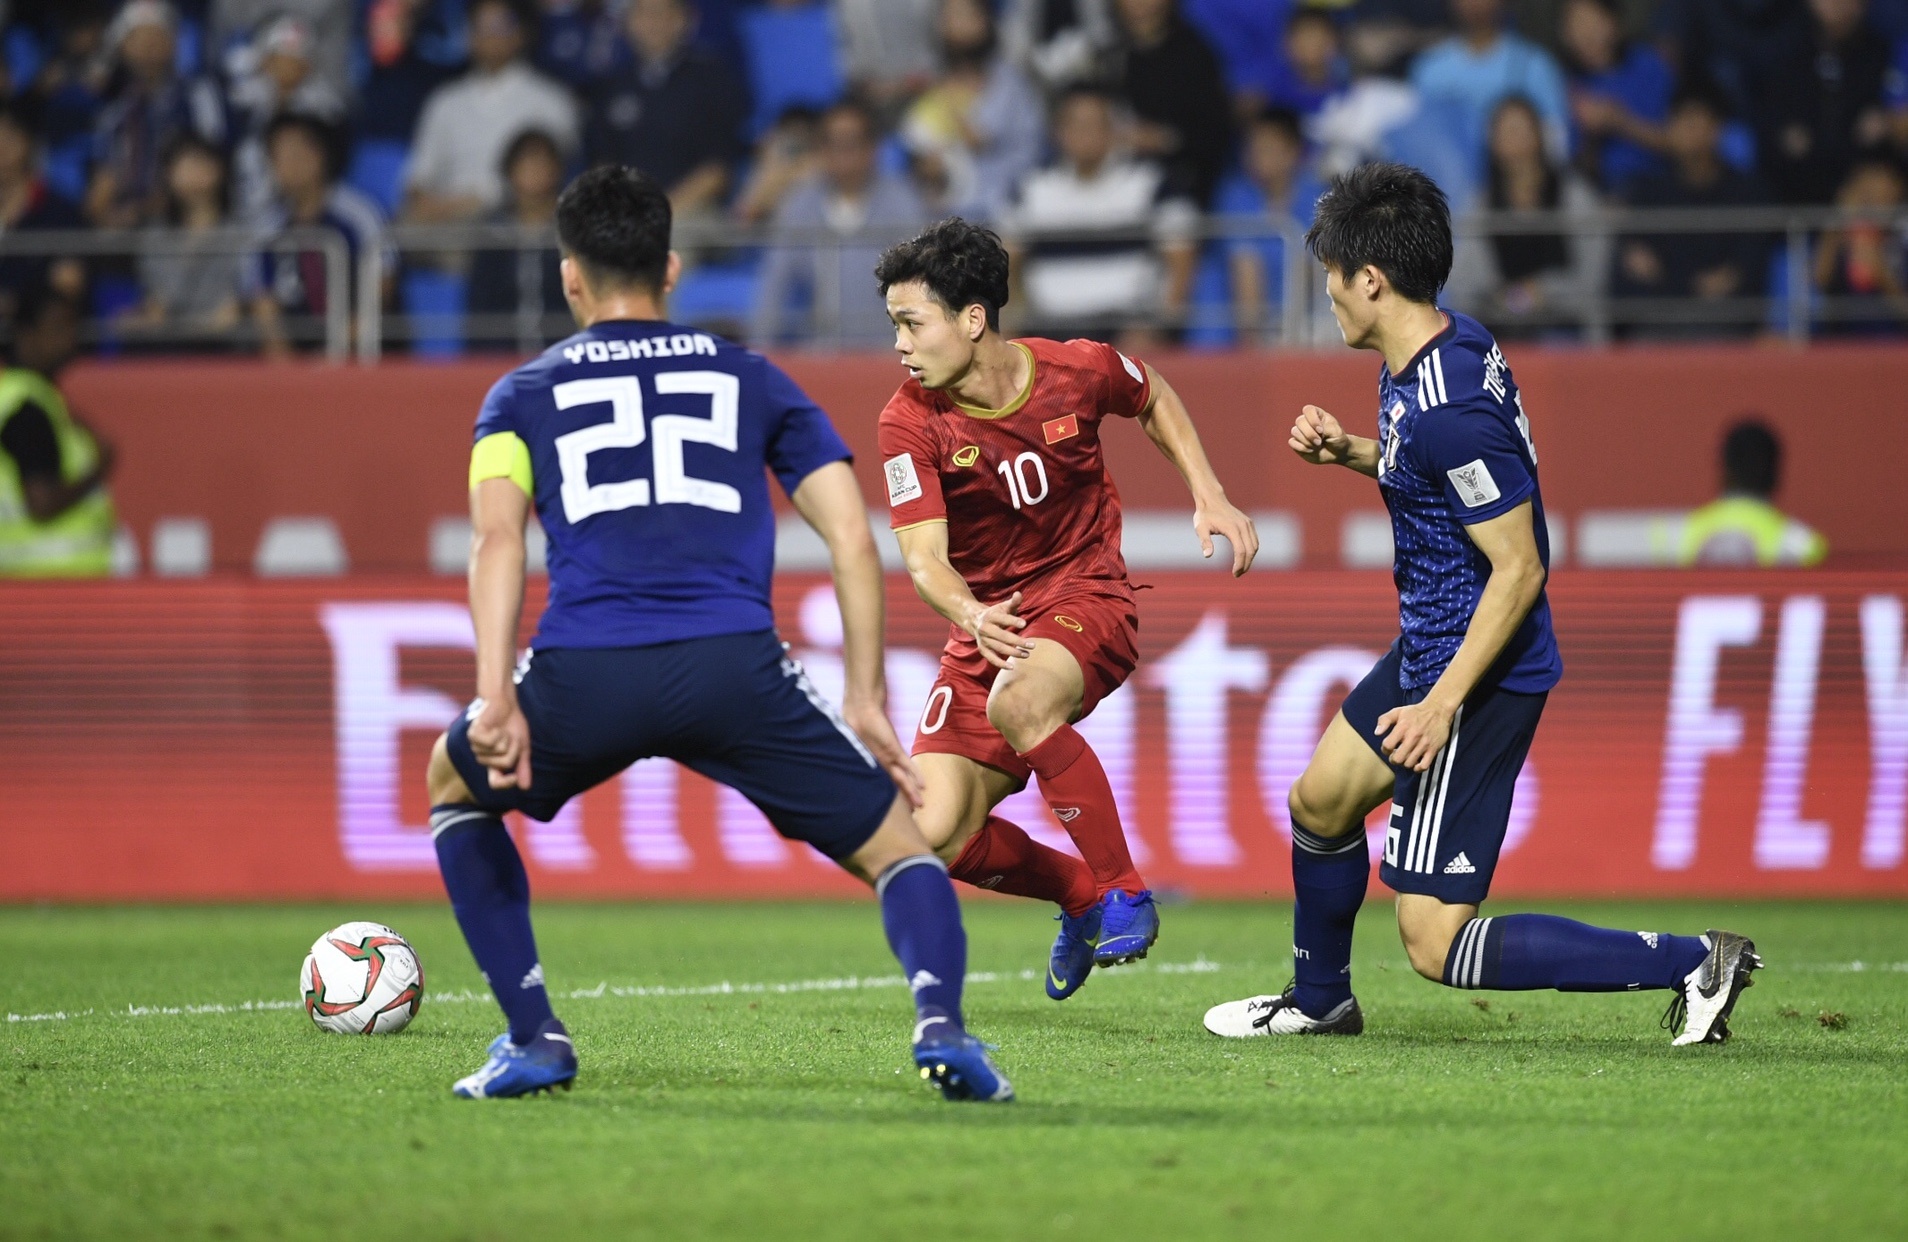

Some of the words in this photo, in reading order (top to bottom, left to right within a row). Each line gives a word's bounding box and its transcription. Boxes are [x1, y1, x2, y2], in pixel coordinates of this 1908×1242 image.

[563, 333, 718, 364] YOSHIDA
[553, 370, 742, 525] 22
[997, 451, 1049, 510] 10
[1650, 594, 1908, 871] FLY
